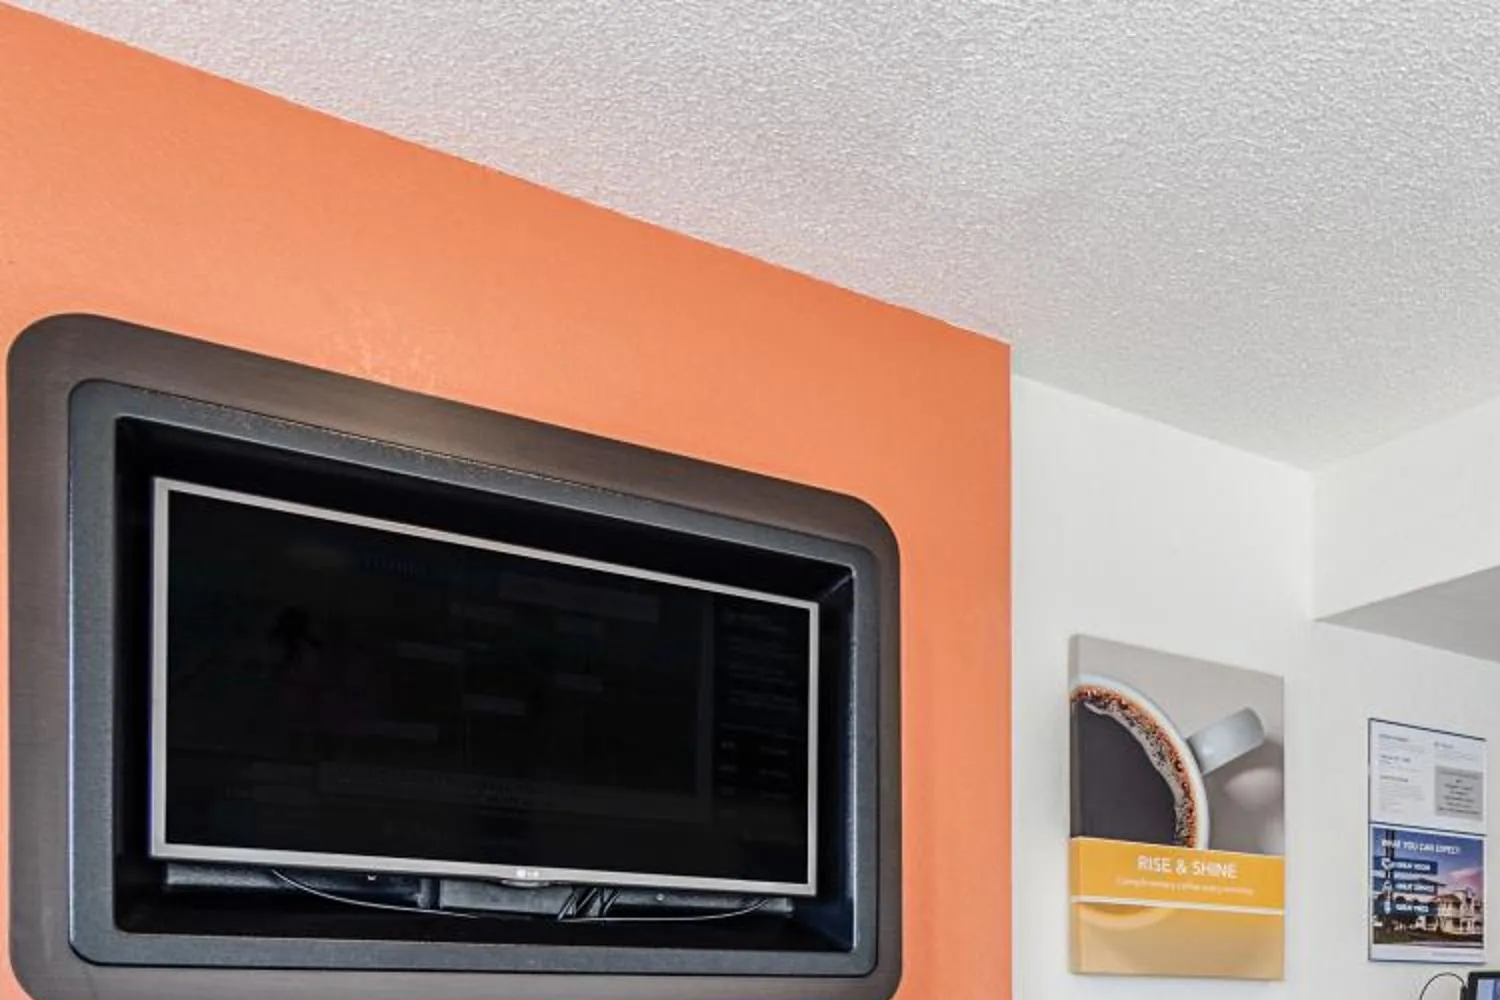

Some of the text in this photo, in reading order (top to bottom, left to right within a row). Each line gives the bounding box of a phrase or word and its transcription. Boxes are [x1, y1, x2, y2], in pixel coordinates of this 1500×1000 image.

[1137, 854, 1238, 879] RISE & SHINE
